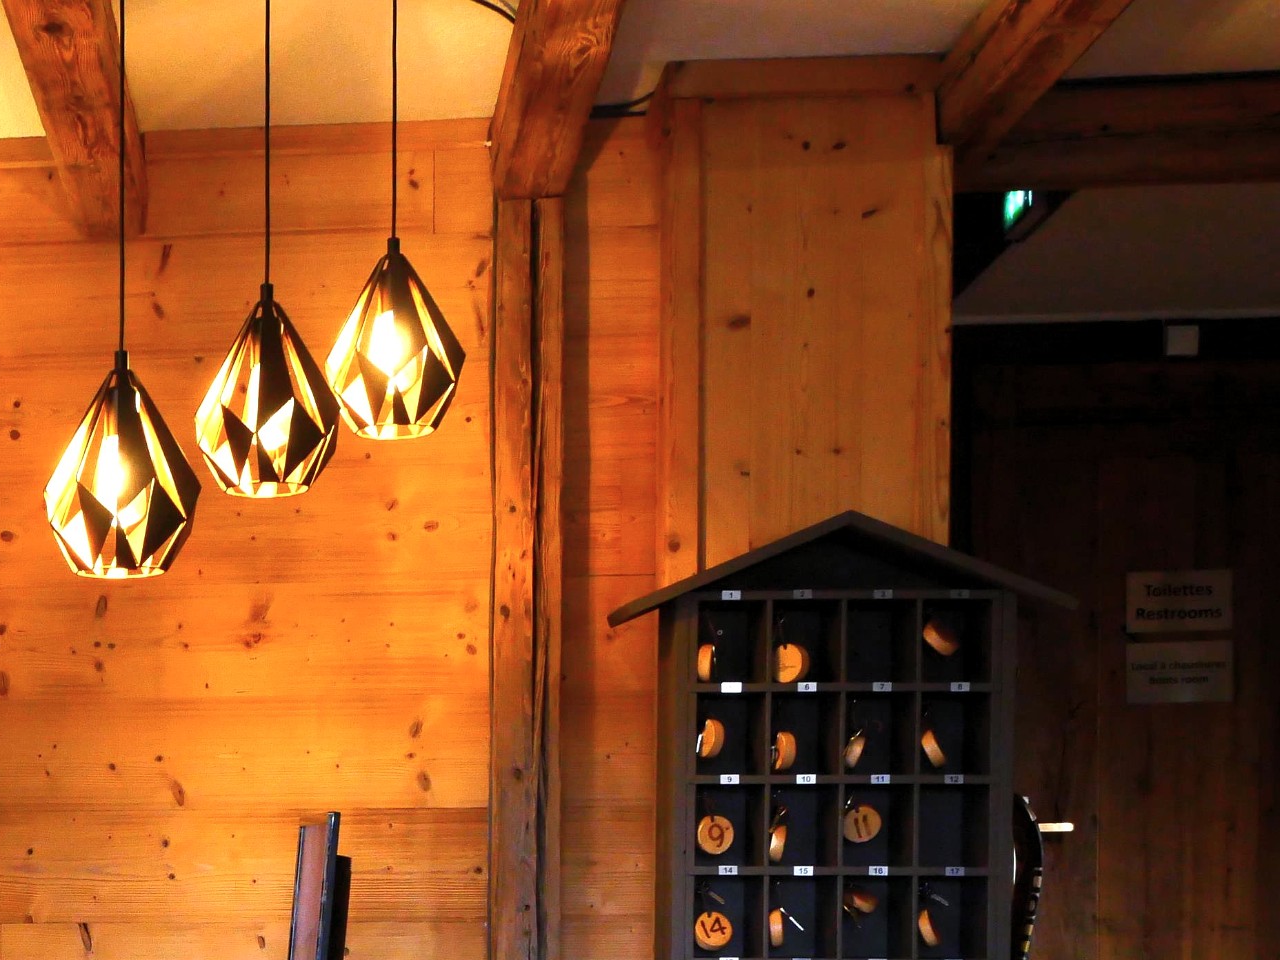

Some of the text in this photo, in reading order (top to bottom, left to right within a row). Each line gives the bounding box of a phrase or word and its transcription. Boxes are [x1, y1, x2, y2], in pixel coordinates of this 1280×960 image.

[1144, 585, 1213, 597] Toilettes
[1135, 608, 1222, 620] Restrooms
[708, 822, 727, 848] 9
[702, 917, 727, 937] 14
